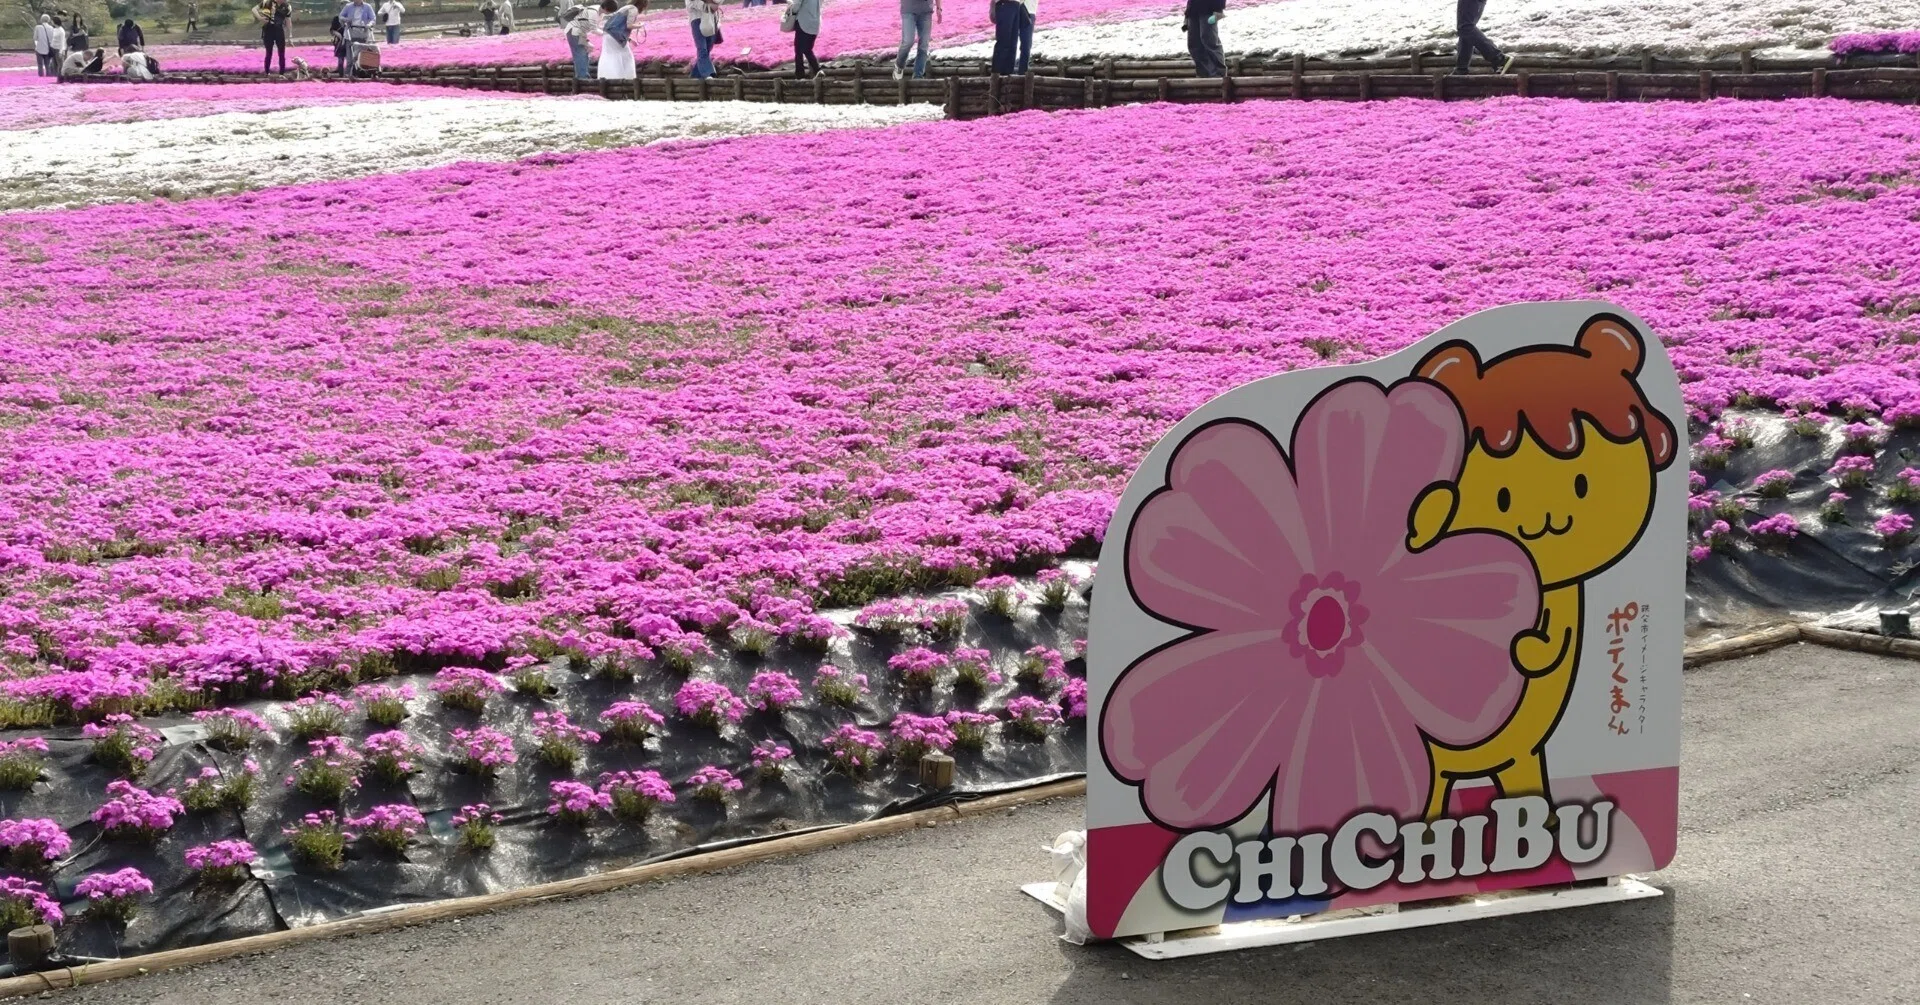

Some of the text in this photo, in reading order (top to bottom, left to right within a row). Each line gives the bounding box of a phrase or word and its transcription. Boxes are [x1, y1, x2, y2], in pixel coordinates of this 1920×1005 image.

[1606, 601, 1639, 736] ポテくまくん
[1162, 796, 1614, 910] CHICHIBU
